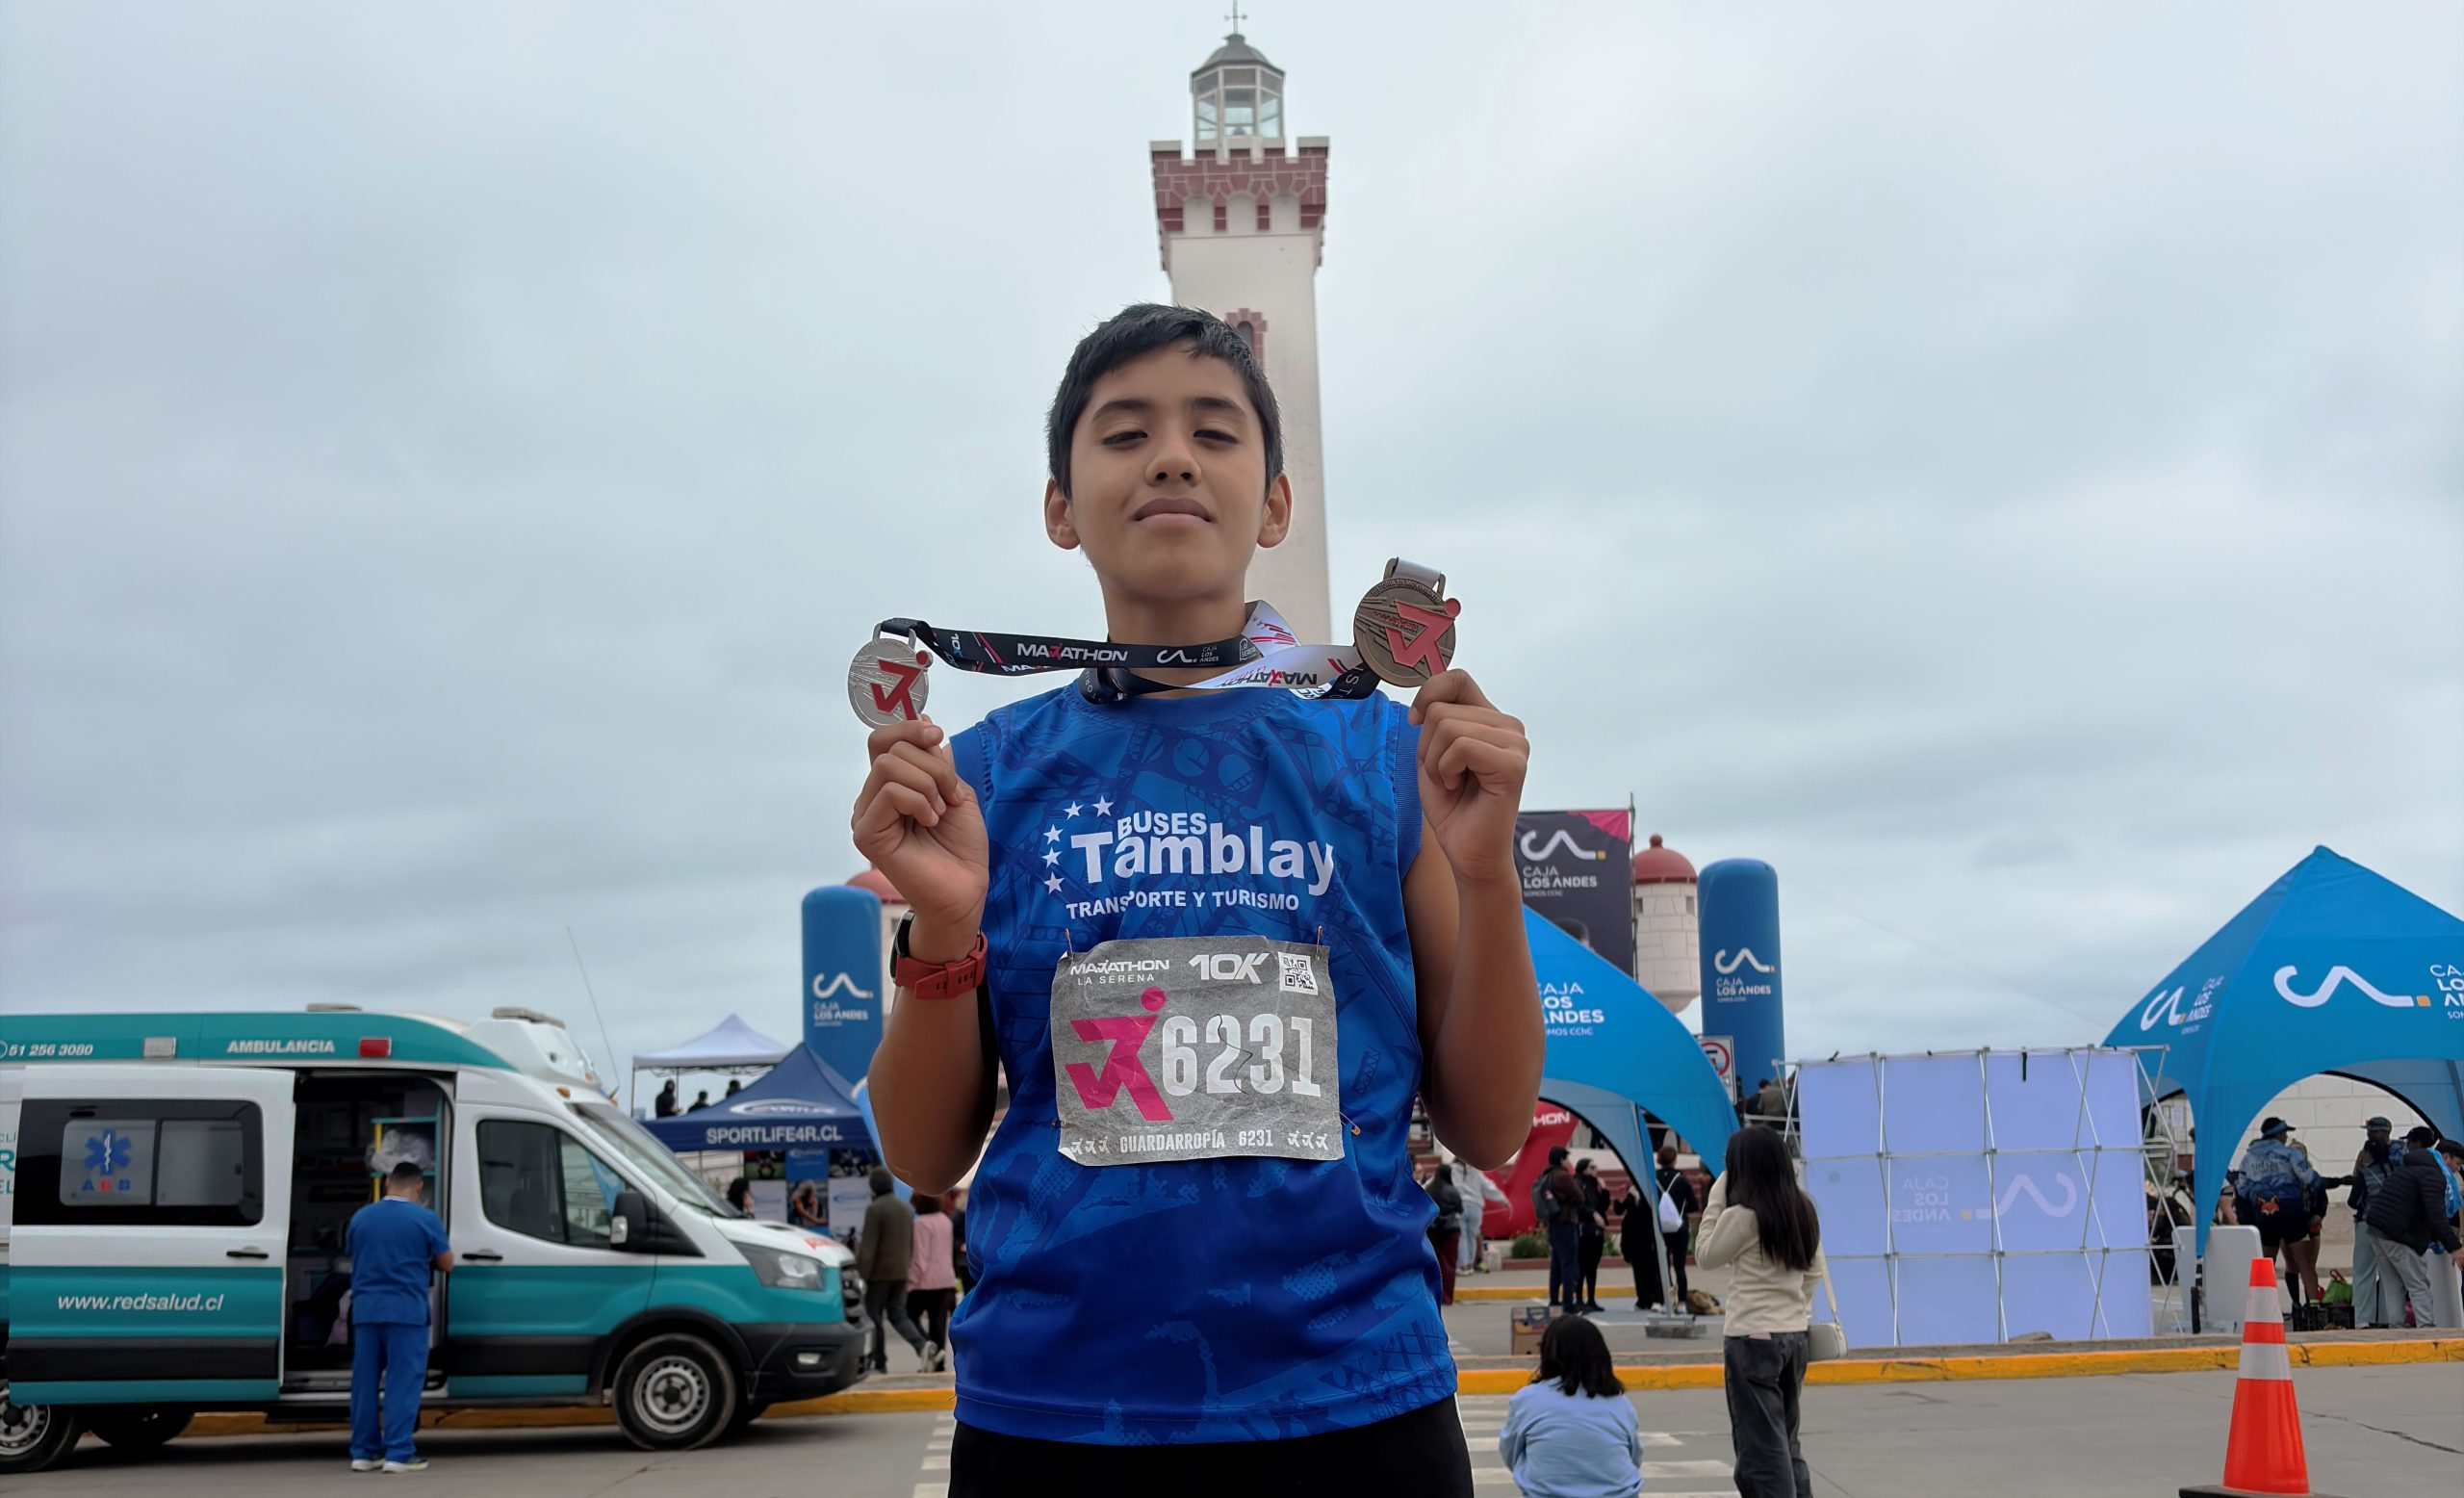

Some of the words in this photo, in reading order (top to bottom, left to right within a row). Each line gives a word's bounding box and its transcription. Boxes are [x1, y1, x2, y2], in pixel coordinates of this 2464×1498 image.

[1116, 811, 1207, 840] BUSES
[1070, 822, 1335, 896] Tamblay
[1523, 865, 1558, 877] CAJA
[1524, 877, 1550, 889] LOS
[1553, 875, 1598, 888] ANDES
[1193, 891, 1206, 908] Y
[1211, 889, 1299, 911] TURISMO
[1188, 953, 1270, 984] 10K
[2430, 964, 2464, 976] CA
[1077, 977, 1092, 986] LA
[1099, 974, 1155, 984] SERENA
[1538, 982, 1584, 994] AJA
[1738, 985, 1771, 995] ANDES
[1542, 995, 1573, 1010] OS
[227, 1040, 335, 1053] AMBULANCIA
[1162, 1013, 1322, 1098] 6231
[706, 1124, 843, 1146] SPORTLIFE4R.CL
[1119, 1128, 1225, 1153] GUARDARROPÍA
[1238, 1129, 1273, 1147] 6231
[57, 1292, 224, 1311] www.redsalud.cl
